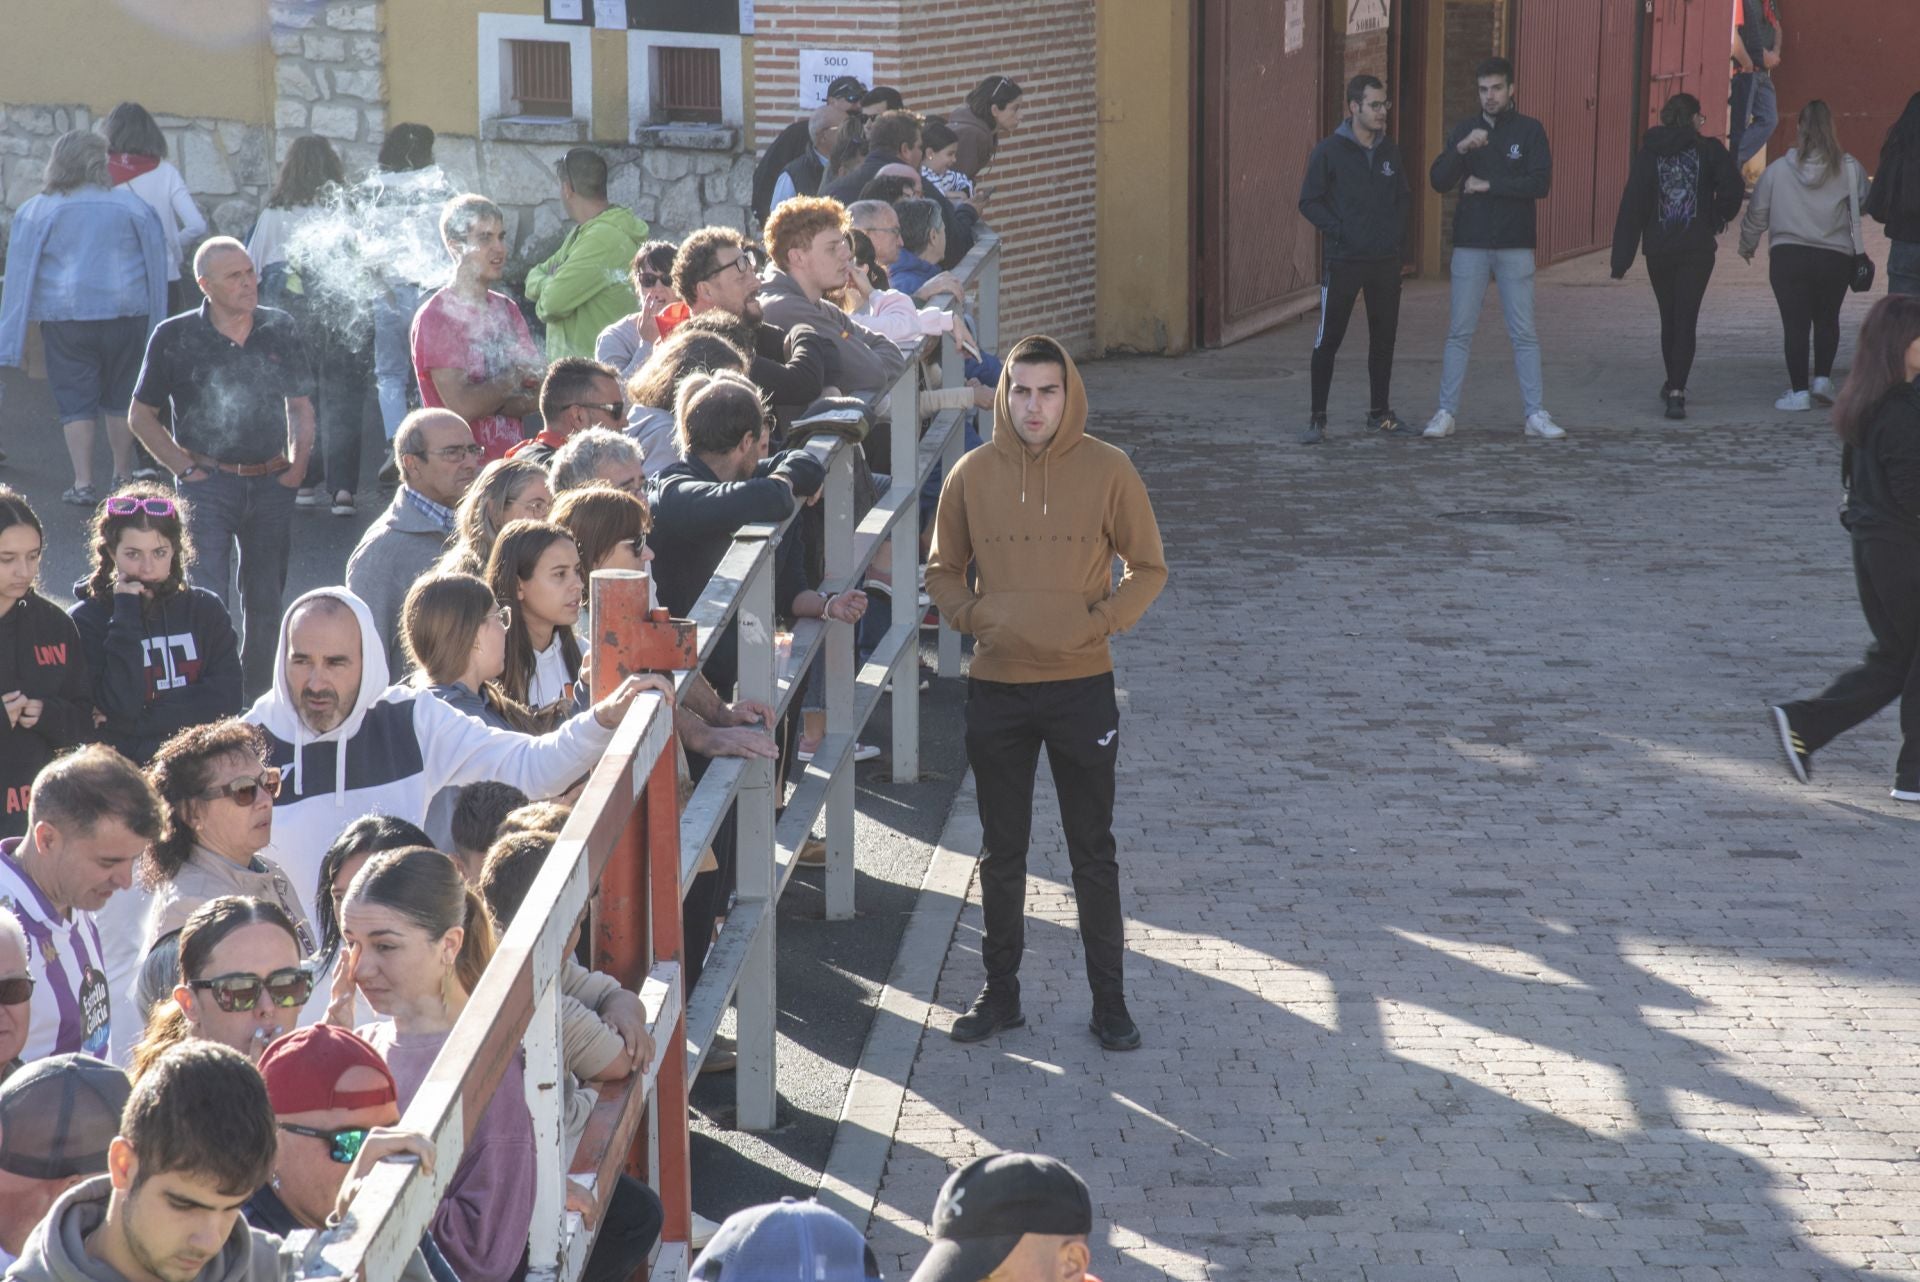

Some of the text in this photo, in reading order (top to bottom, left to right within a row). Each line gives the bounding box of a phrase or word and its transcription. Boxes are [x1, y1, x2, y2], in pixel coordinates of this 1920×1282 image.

[824, 56, 849, 66] SOLO
[83, 982, 106, 1016] Estrella
[87, 1002, 108, 1035] Galicia
